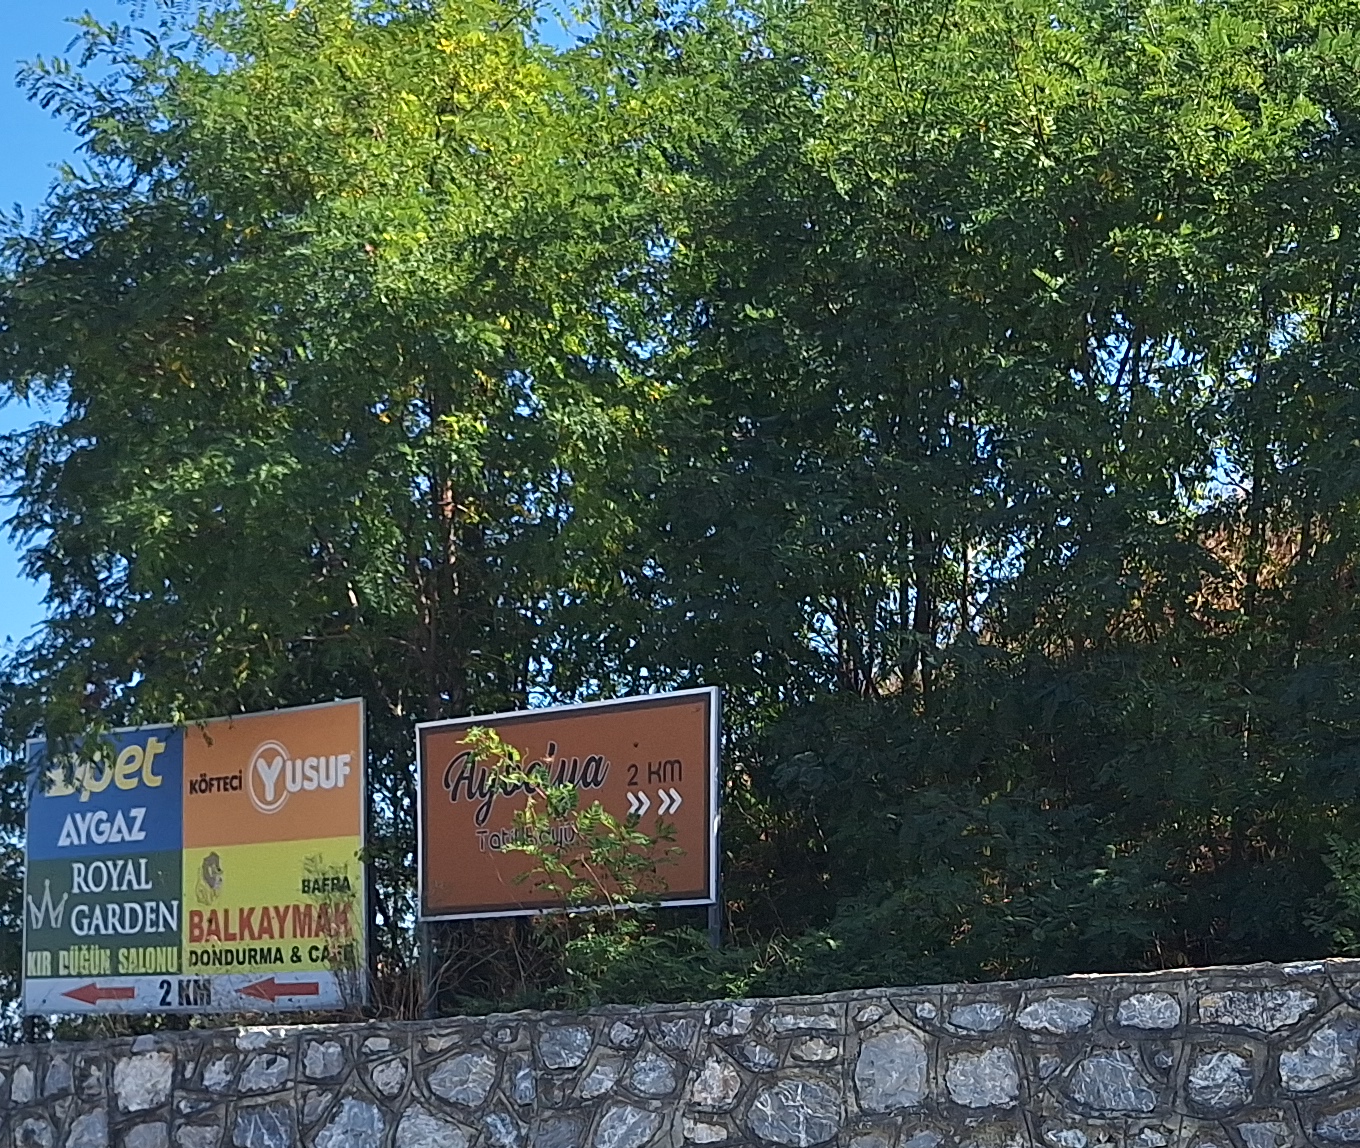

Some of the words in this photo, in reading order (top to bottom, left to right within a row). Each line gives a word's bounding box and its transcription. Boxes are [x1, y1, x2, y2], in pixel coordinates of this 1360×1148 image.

[189, 769, 243, 795] KÖFTECİ
[255, 753, 352, 802] YUSUF
[627, 763, 639, 787] 2
[648, 759, 682, 785] KM
[56, 807, 147, 848] AYGAZ
[71, 858, 153, 894] ROYAL
[301, 875, 352, 894] BAFRA
[70, 900, 180, 937] GARDEN
[189, 902, 354, 943] BALKAYMAK
[27, 951, 52, 977] KIR
[59, 944, 112, 976] DÜĞÜN
[118, 947, 179, 974] SALONU
[189, 946, 284, 967] DONDURMA
[290, 945, 302, 964] &
[159, 979, 172, 1006] 2
[178, 978, 212, 1006] KM
